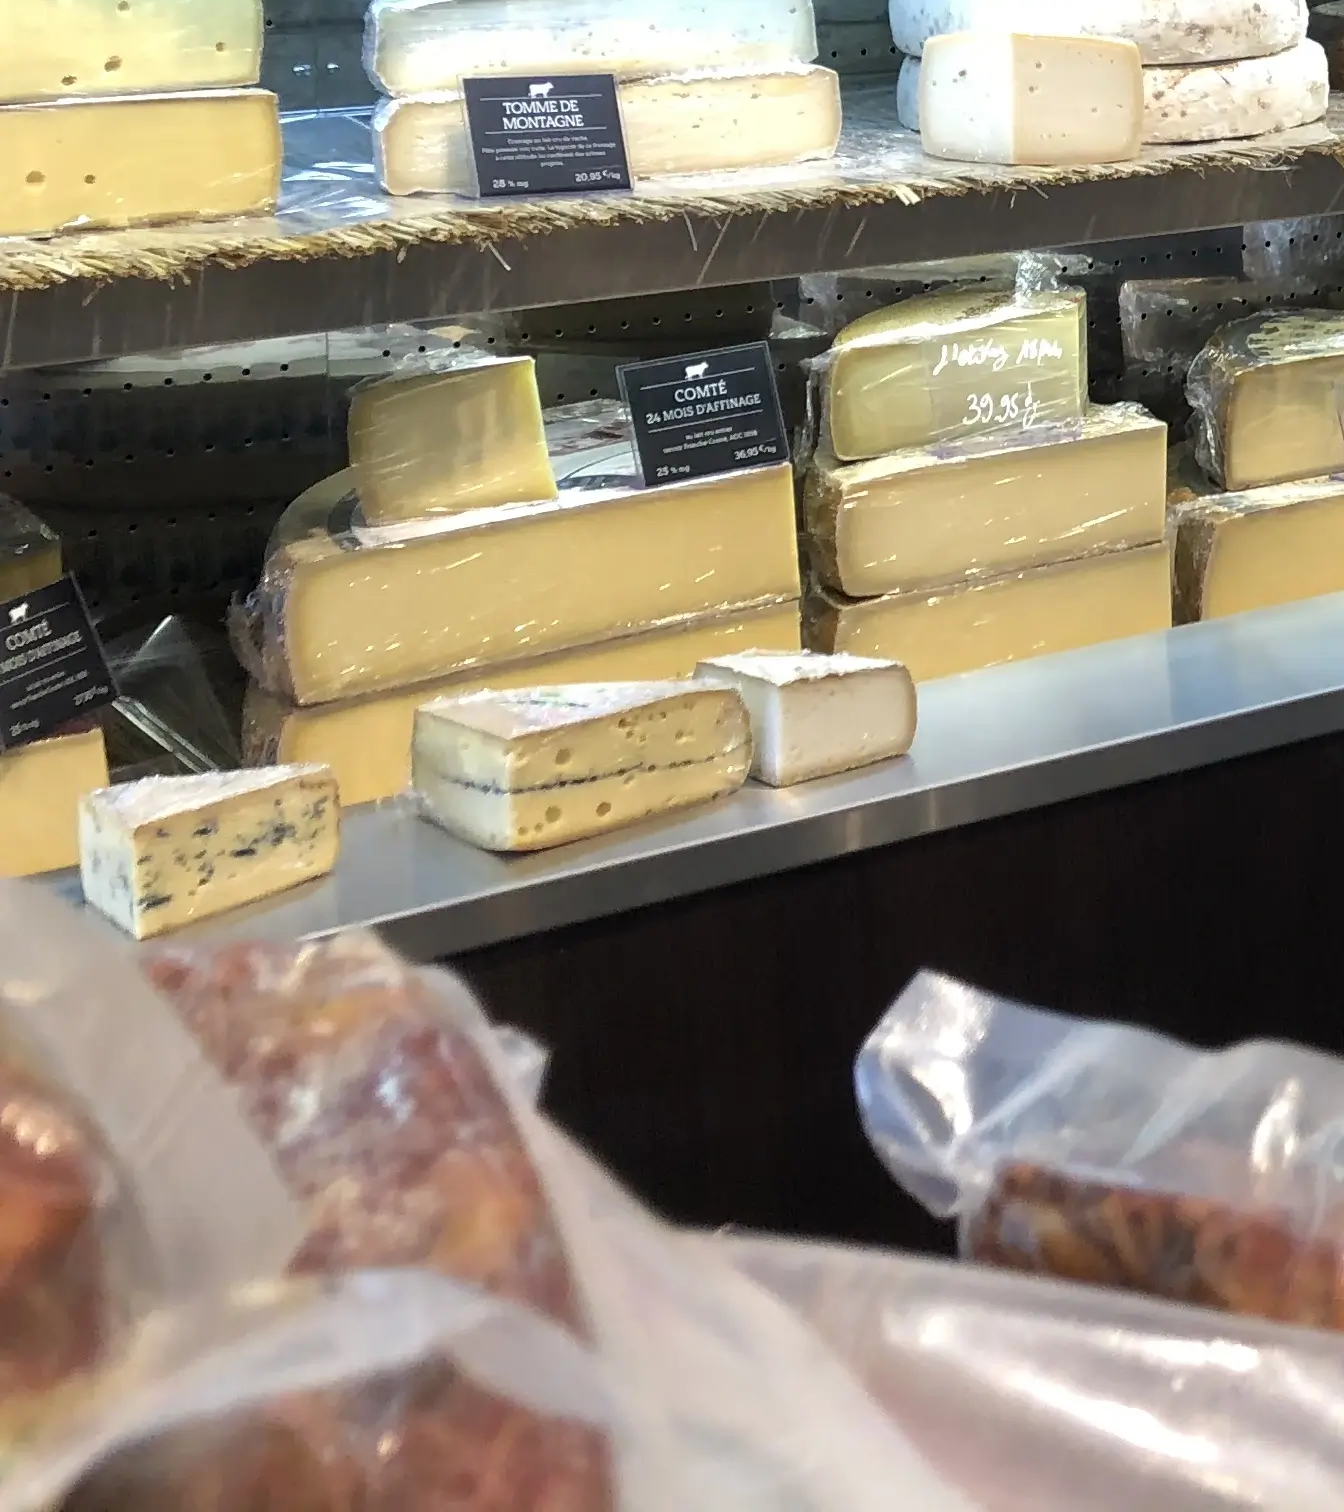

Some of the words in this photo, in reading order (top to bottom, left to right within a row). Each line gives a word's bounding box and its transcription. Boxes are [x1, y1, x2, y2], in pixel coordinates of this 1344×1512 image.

[502, 100, 558, 115] TOMME
[559, 100, 579, 112] DE
[502, 114, 584, 130] MONTAGNE
[674, 379, 728, 402] COMTÉ
[646, 413, 661, 425] 24
[662, 406, 694, 422] MOIS
[696, 393, 762, 416] D'AFFINAGE
[5, 618, 52, 651] COMTÉ
